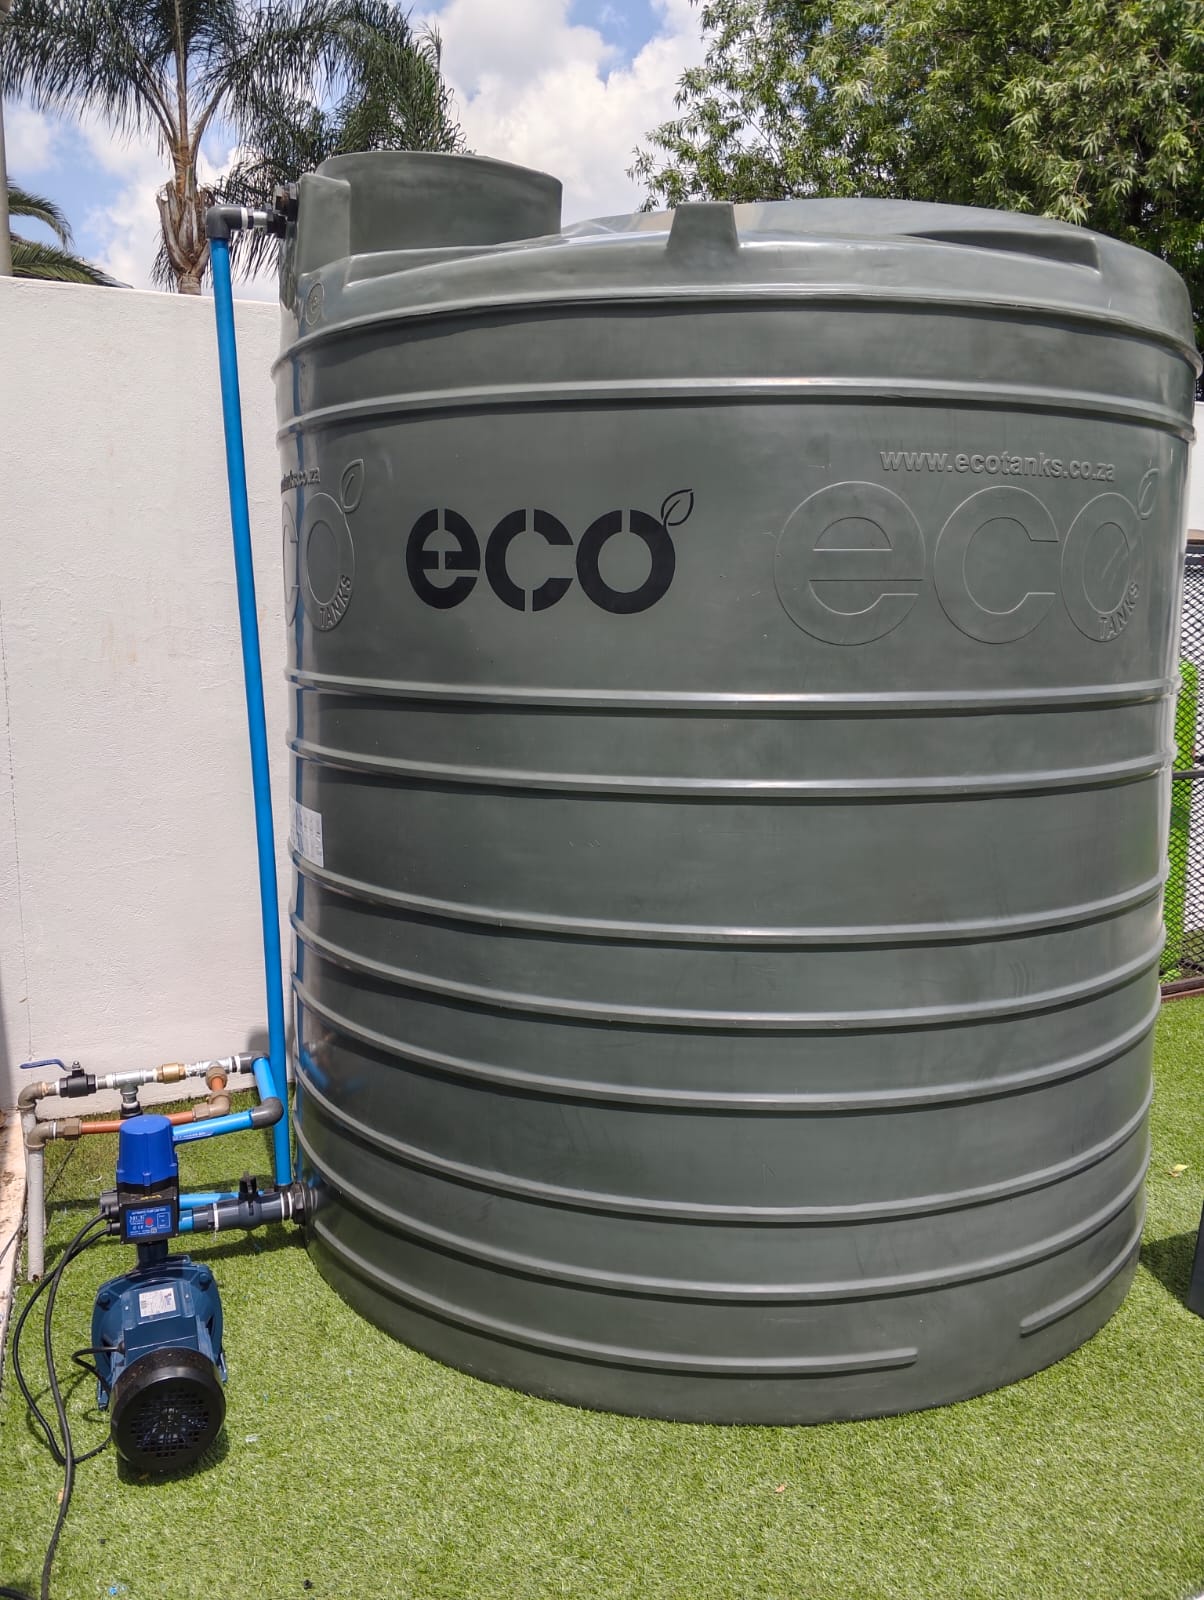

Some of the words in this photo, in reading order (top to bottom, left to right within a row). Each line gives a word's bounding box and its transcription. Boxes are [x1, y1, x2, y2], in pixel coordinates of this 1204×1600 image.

[879, 451, 1116, 482] www.ecotanks.co.za
[405, 508, 677, 615] eco
[774, 481, 1145, 646] eco
[318, 574, 352, 630] TANKS
[1098, 582, 1140, 640] TANKS
